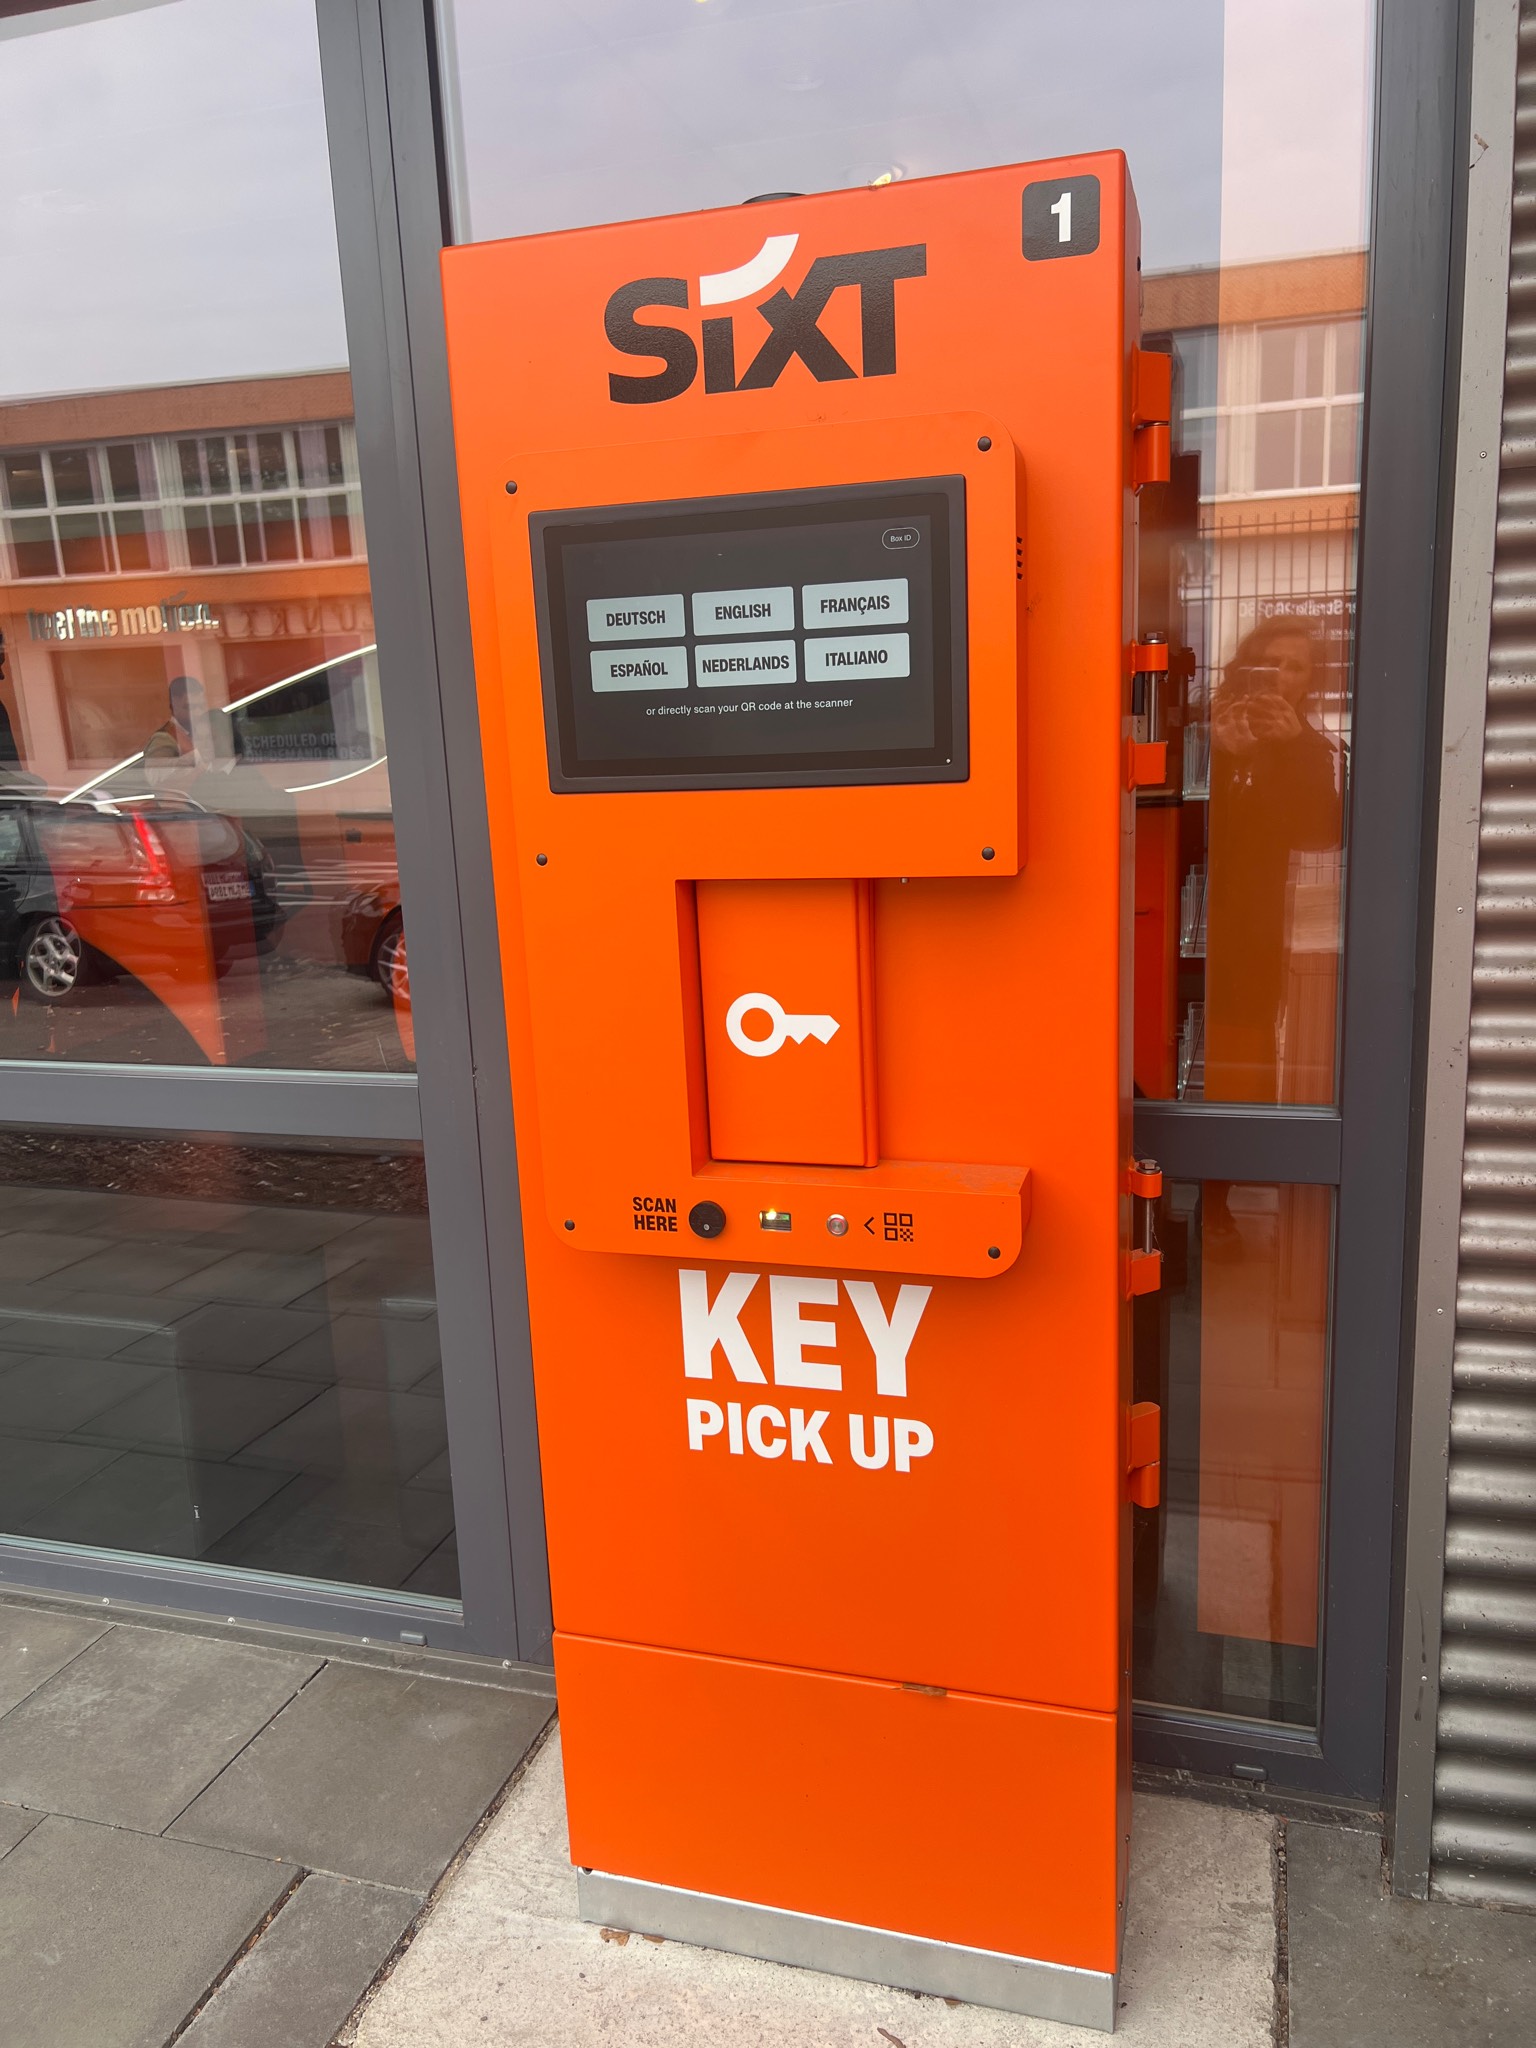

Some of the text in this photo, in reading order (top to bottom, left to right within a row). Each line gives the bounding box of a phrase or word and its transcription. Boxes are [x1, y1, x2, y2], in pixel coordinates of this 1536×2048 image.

[1050, 192, 1072, 243] 1
[890, 535, 903, 543] Box
[715, 603, 771, 620] ENGLISH
[820, 595, 890, 615] FRANÇAIS
[76, 604, 119, 638] the
[606, 610, 666, 627] DEUTSCH
[702, 655, 790, 673] NEDERLANDS
[825, 649, 888, 667] ITALIANO
[610, 660, 668, 677] ESPAÑOL
[658, 705, 691, 716] directly
[693, 706, 716, 714] scan
[718, 705, 738, 714] your
[741, 702, 756, 712] QR
[758, 701, 782, 711] code
[784, 701, 794, 710] at
[796, 700, 812, 709] the
[814, 700, 853, 709] scanner
[243, 733, 318, 749] SCHEDULED
[327, 746, 364, 760] RDES
[632, 1196, 677, 1213] SCAN
[633, 1214, 678, 1232] HERE
[678, 1269, 933, 1397] KEY
[686, 1398, 935, 1473] PICK UP
